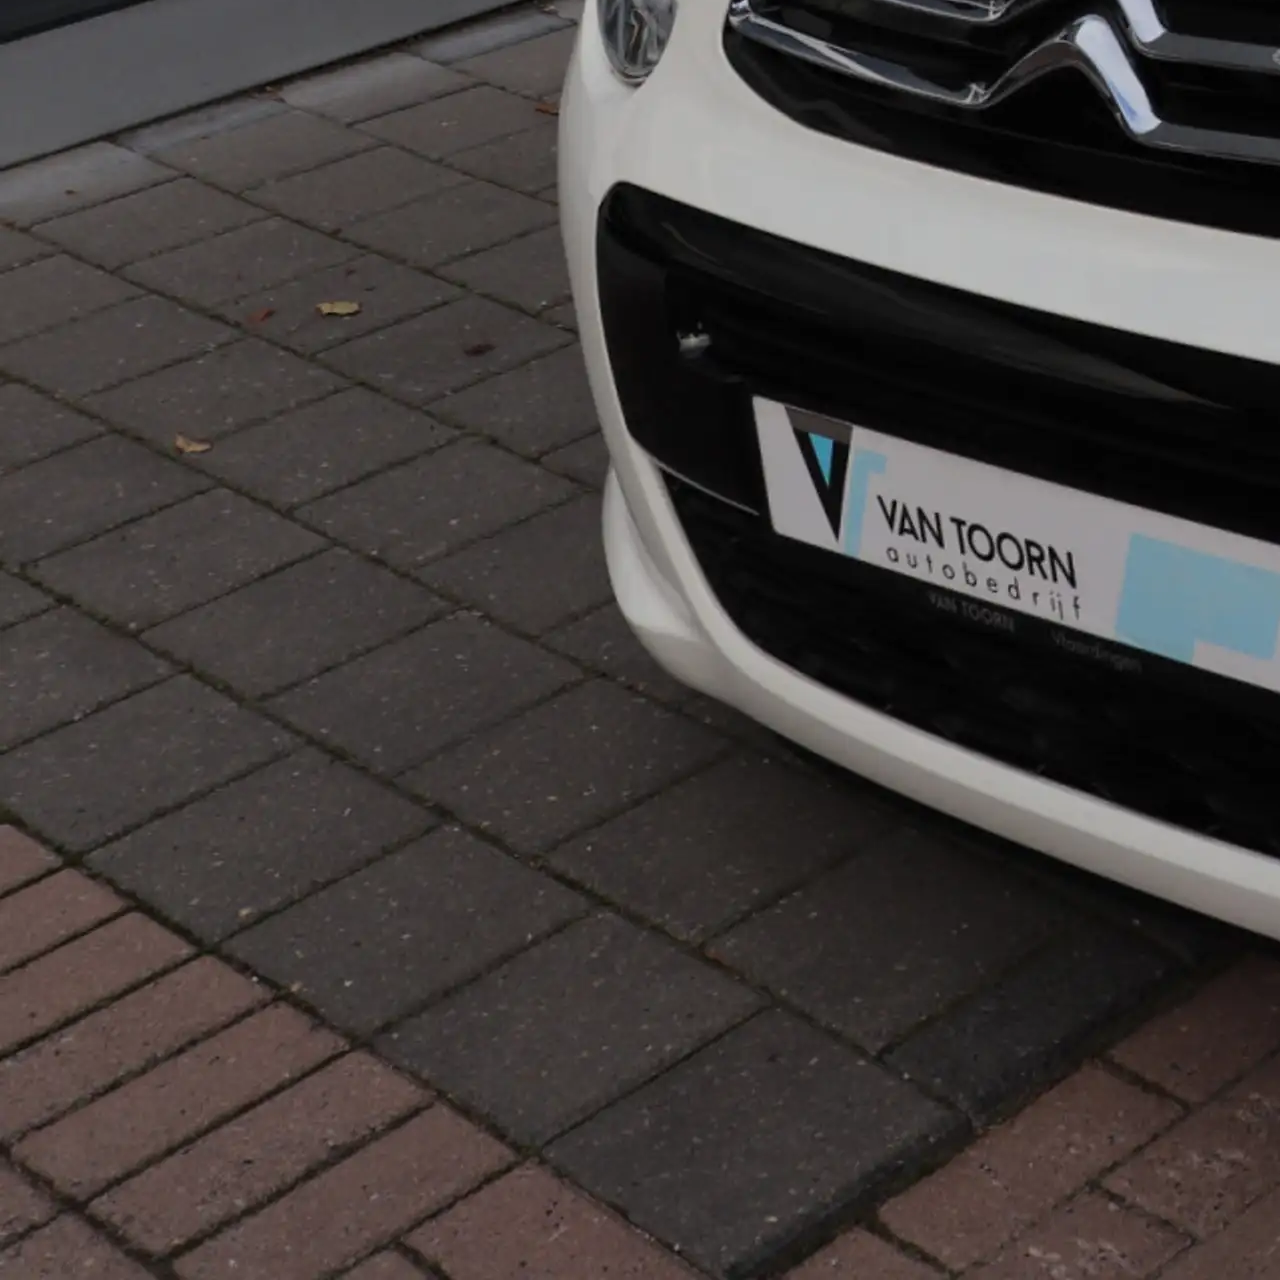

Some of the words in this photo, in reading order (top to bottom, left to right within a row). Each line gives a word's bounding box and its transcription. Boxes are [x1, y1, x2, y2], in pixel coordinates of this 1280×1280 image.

[877, 494, 945, 549] VAN
[949, 516, 1077, 589] TOORN
[886, 546, 1081, 620] autobedrijf
[927, 589, 958, 614] VAN
